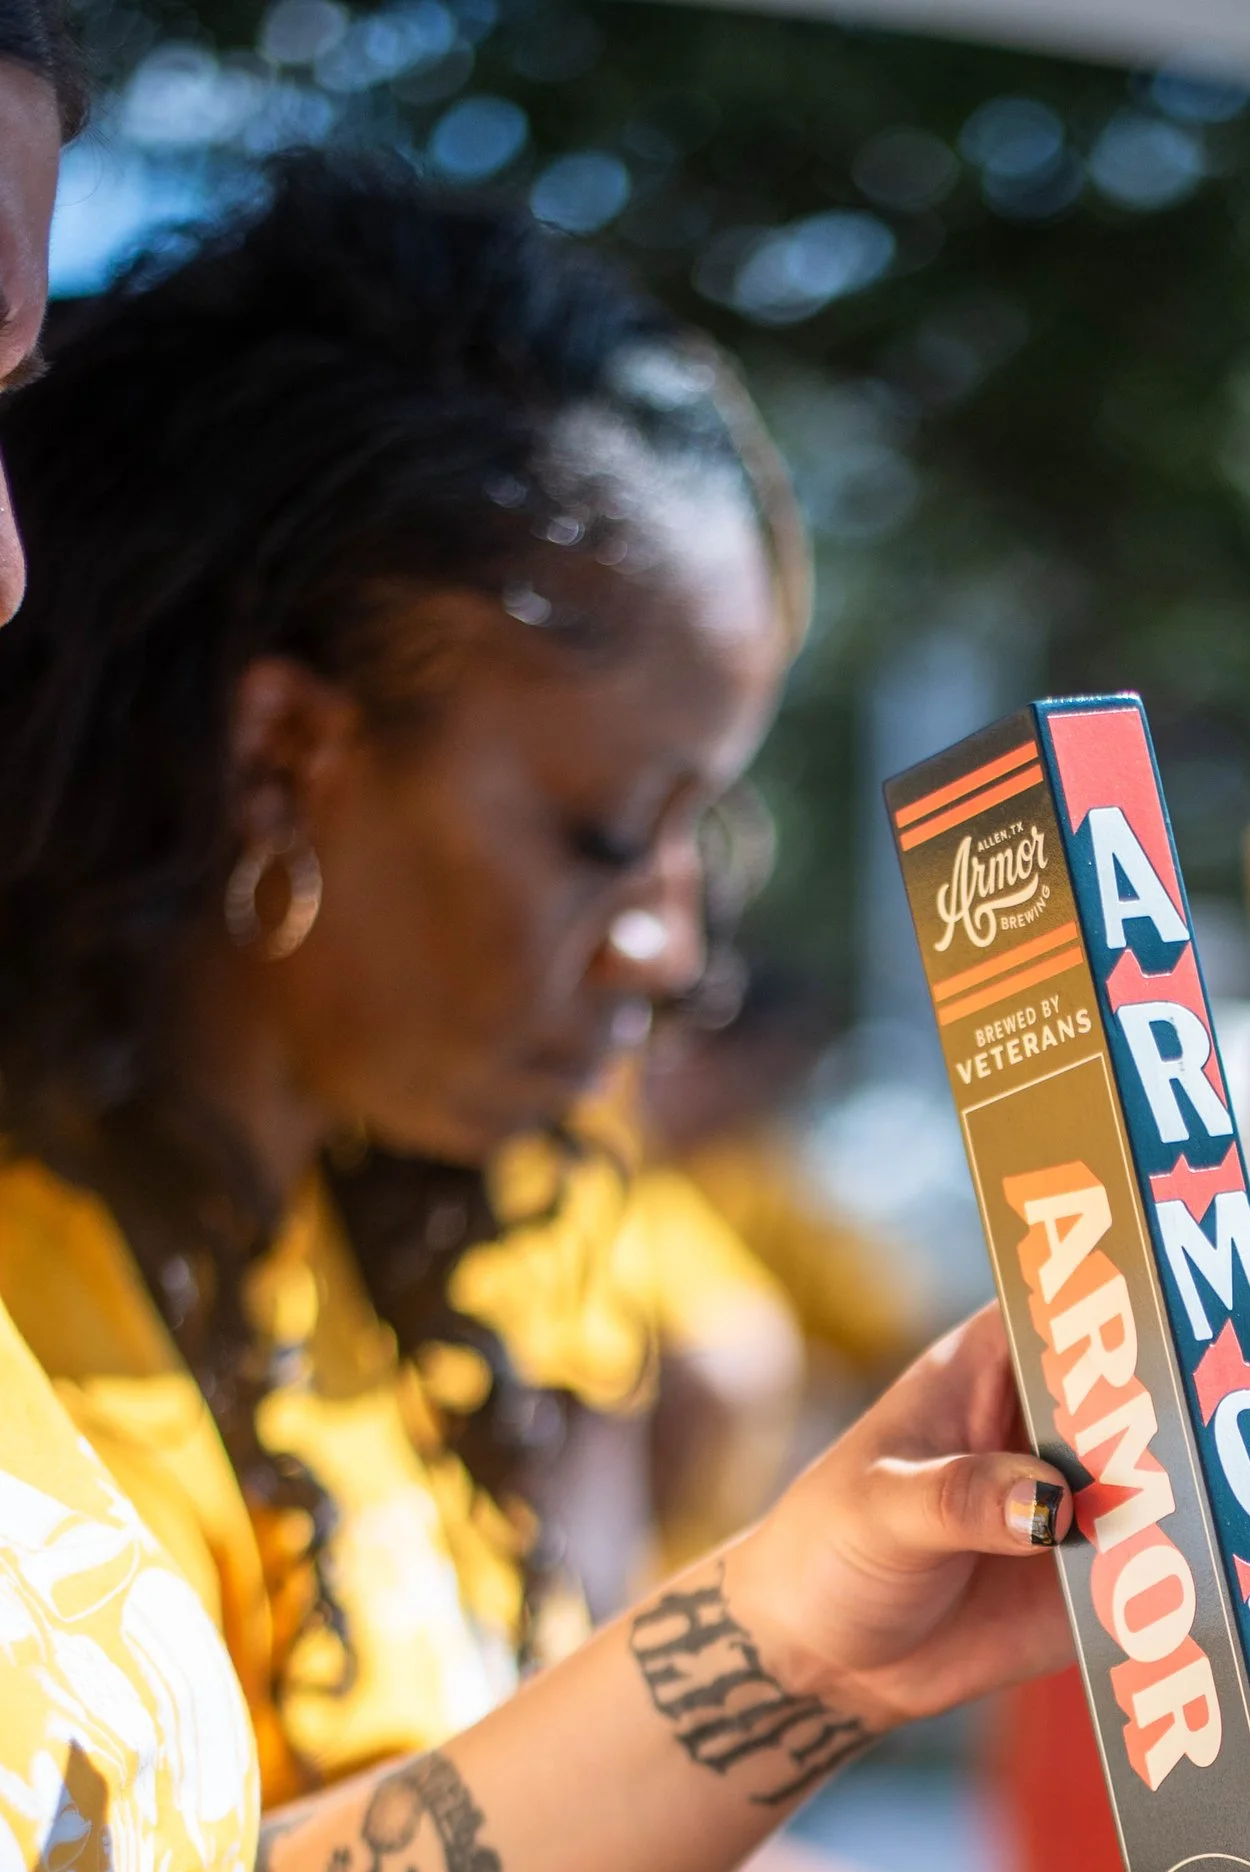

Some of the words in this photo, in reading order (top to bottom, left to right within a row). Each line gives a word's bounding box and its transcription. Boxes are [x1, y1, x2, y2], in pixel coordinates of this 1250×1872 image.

[977, 829, 1011, 853] ALLEN,
[1009, 821, 1025, 836] TX
[933, 825, 1049, 952] Armor
[1000, 884, 1051, 931] BREWING
[955, 1008, 1093, 1085] VETERANS
[975, 1006, 1036, 1047] BREWED
[1041, 995, 1061, 1019] BY
[1003, 1160, 1221, 1792] ARMOR
